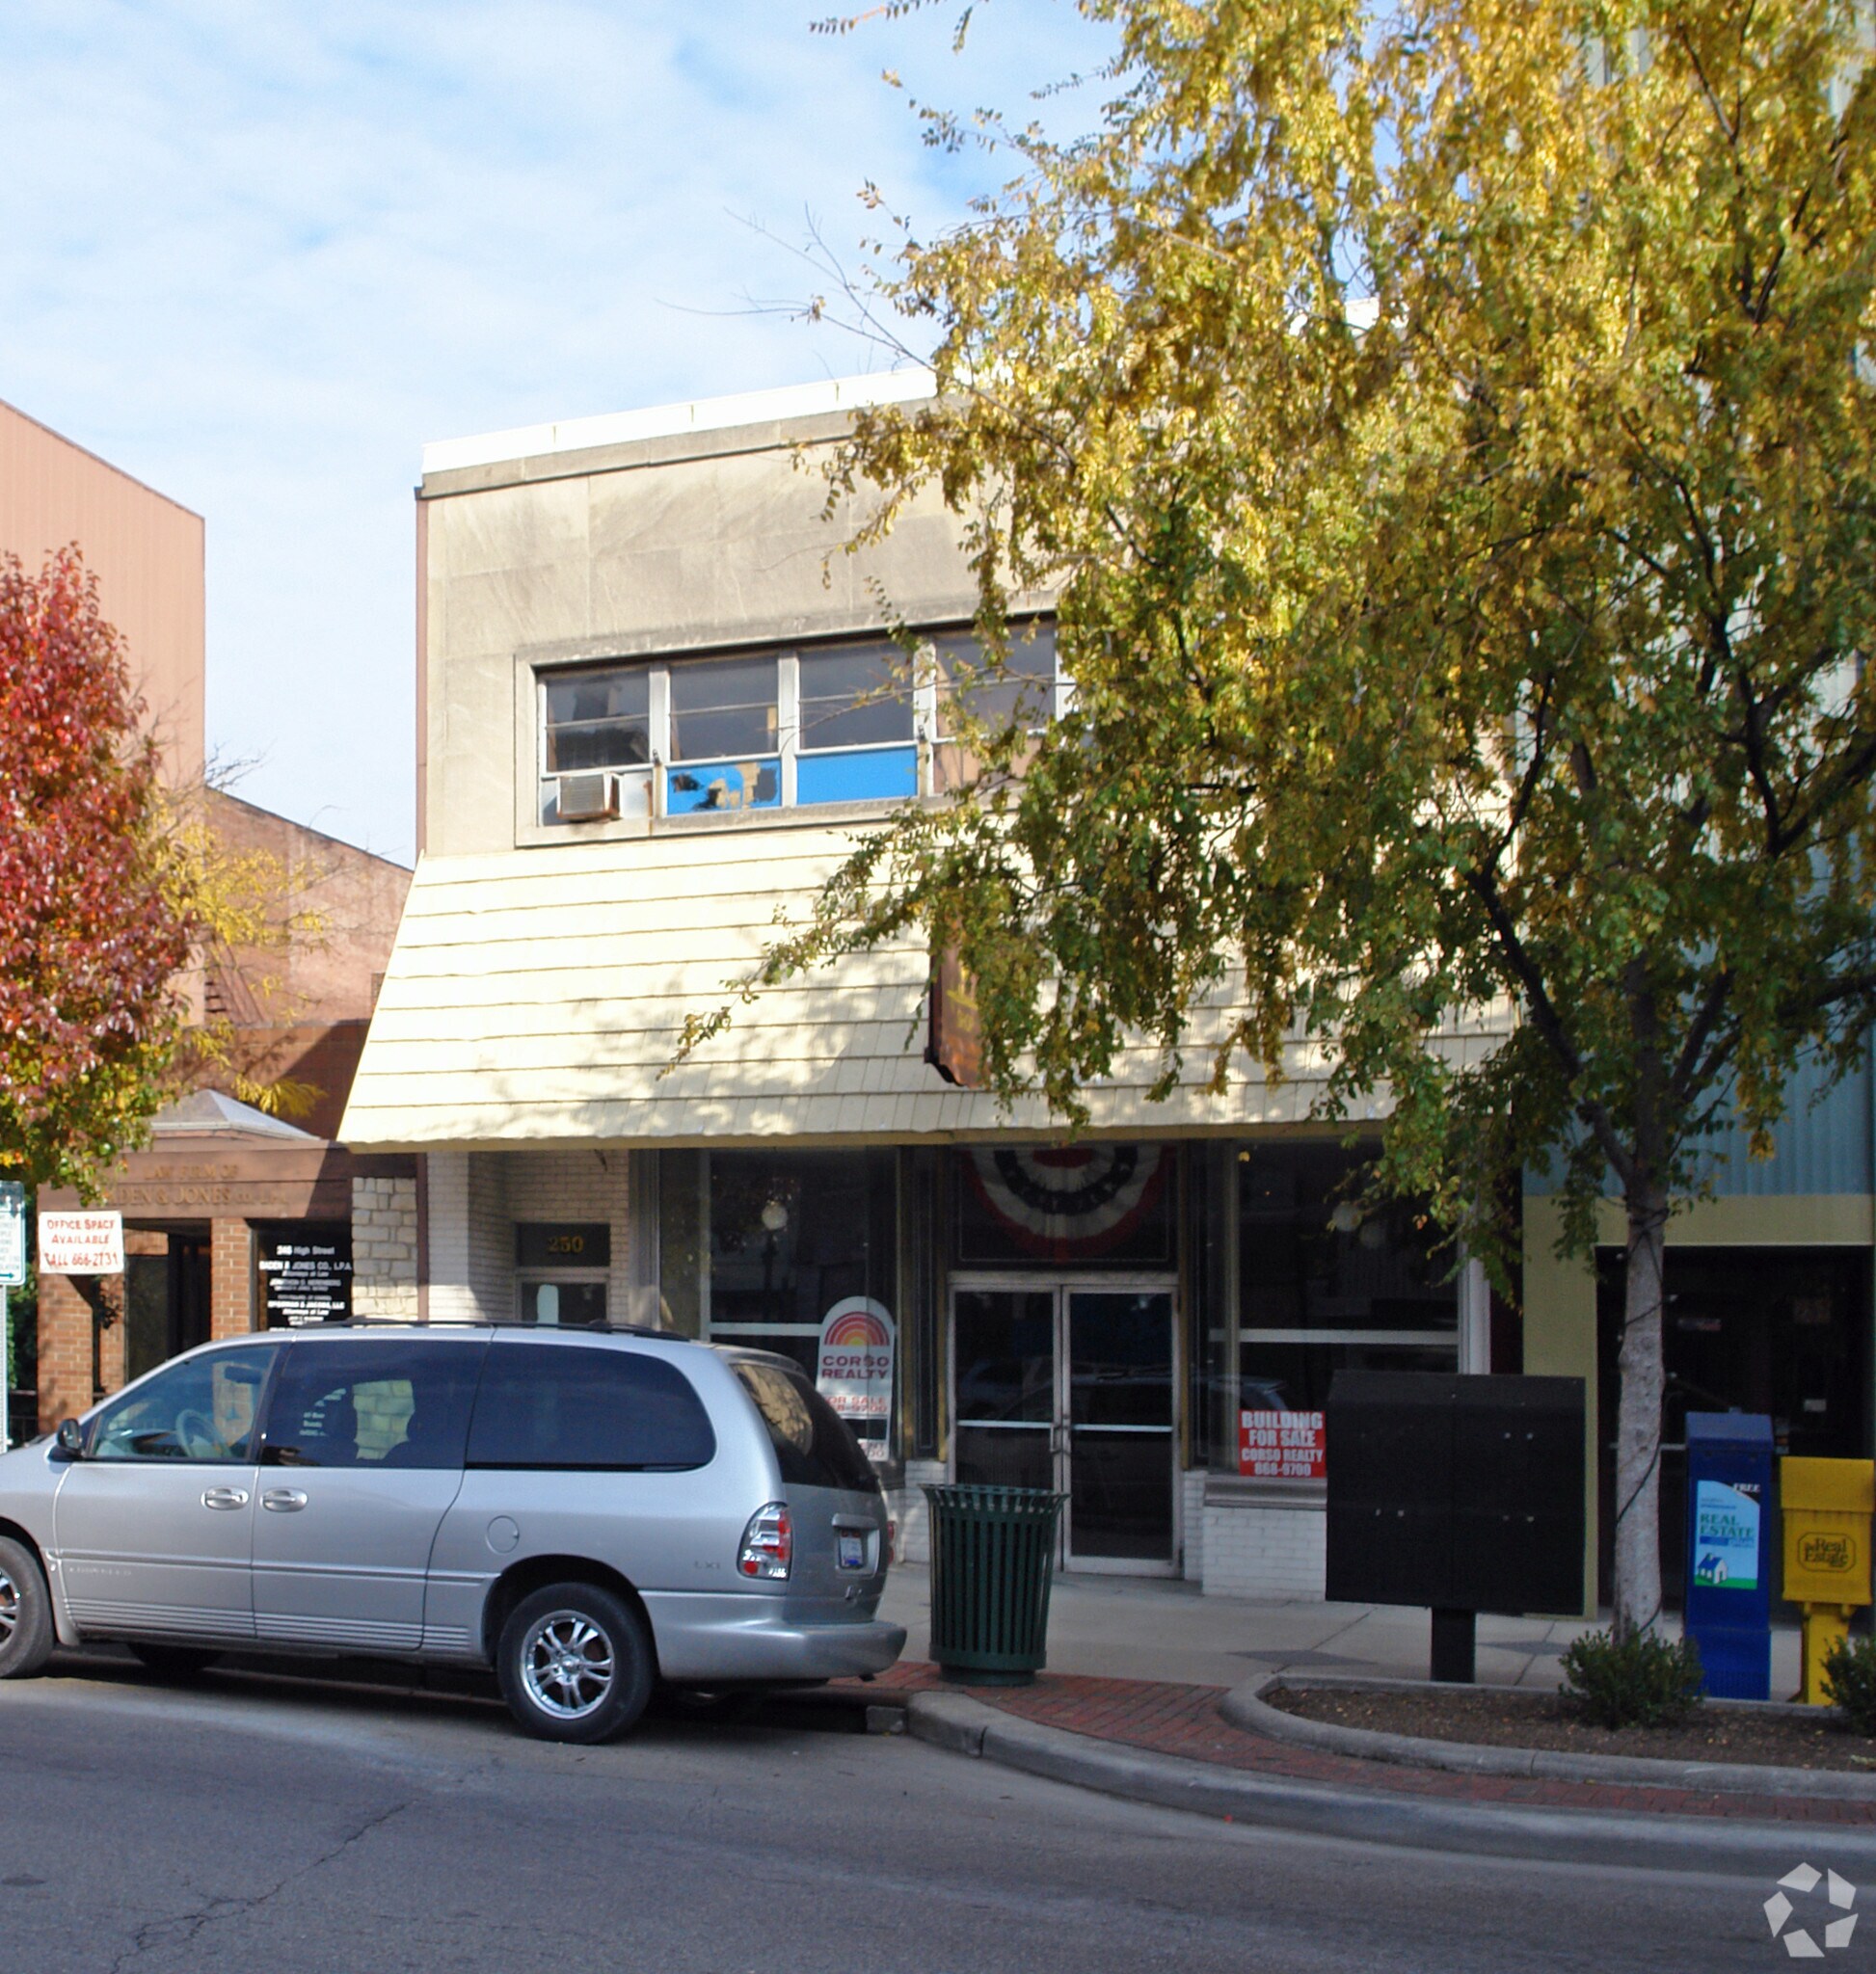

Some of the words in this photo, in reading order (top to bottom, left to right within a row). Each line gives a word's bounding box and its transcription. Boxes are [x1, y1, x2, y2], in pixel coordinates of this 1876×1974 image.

[144, 1165, 174, 1181] LAW
[180, 1164, 216, 1180] FIRM
[221, 1164, 239, 1179] OF
[174, 1187, 231, 1206] JONES
[47, 1219, 82, 1231] OFFICE
[84, 1218, 116, 1231] SPACE
[51, 1234, 110, 1245] AVAILABLE
[44, 1251, 68, 1267] CALL
[822, 1356, 890, 1367] CORSO
[821, 1369, 888, 1379] REALTY
[825, 1397, 845, 1405] OR
[1241, 1410, 1324, 1429] BUILDING
[1248, 1428, 1278, 1447] FOR
[1279, 1429, 1316, 1447] SALE
[1241, 1448, 1281, 1462] CORSO
[1282, 1448, 1324, 1463] REALTY
[1732, 1483, 1760, 1493] FREE
[1700, 1513, 1740, 1526] REAL
[1700, 1526, 1754, 1537] ESTATE
[1814, 1537, 1847, 1553] Real
